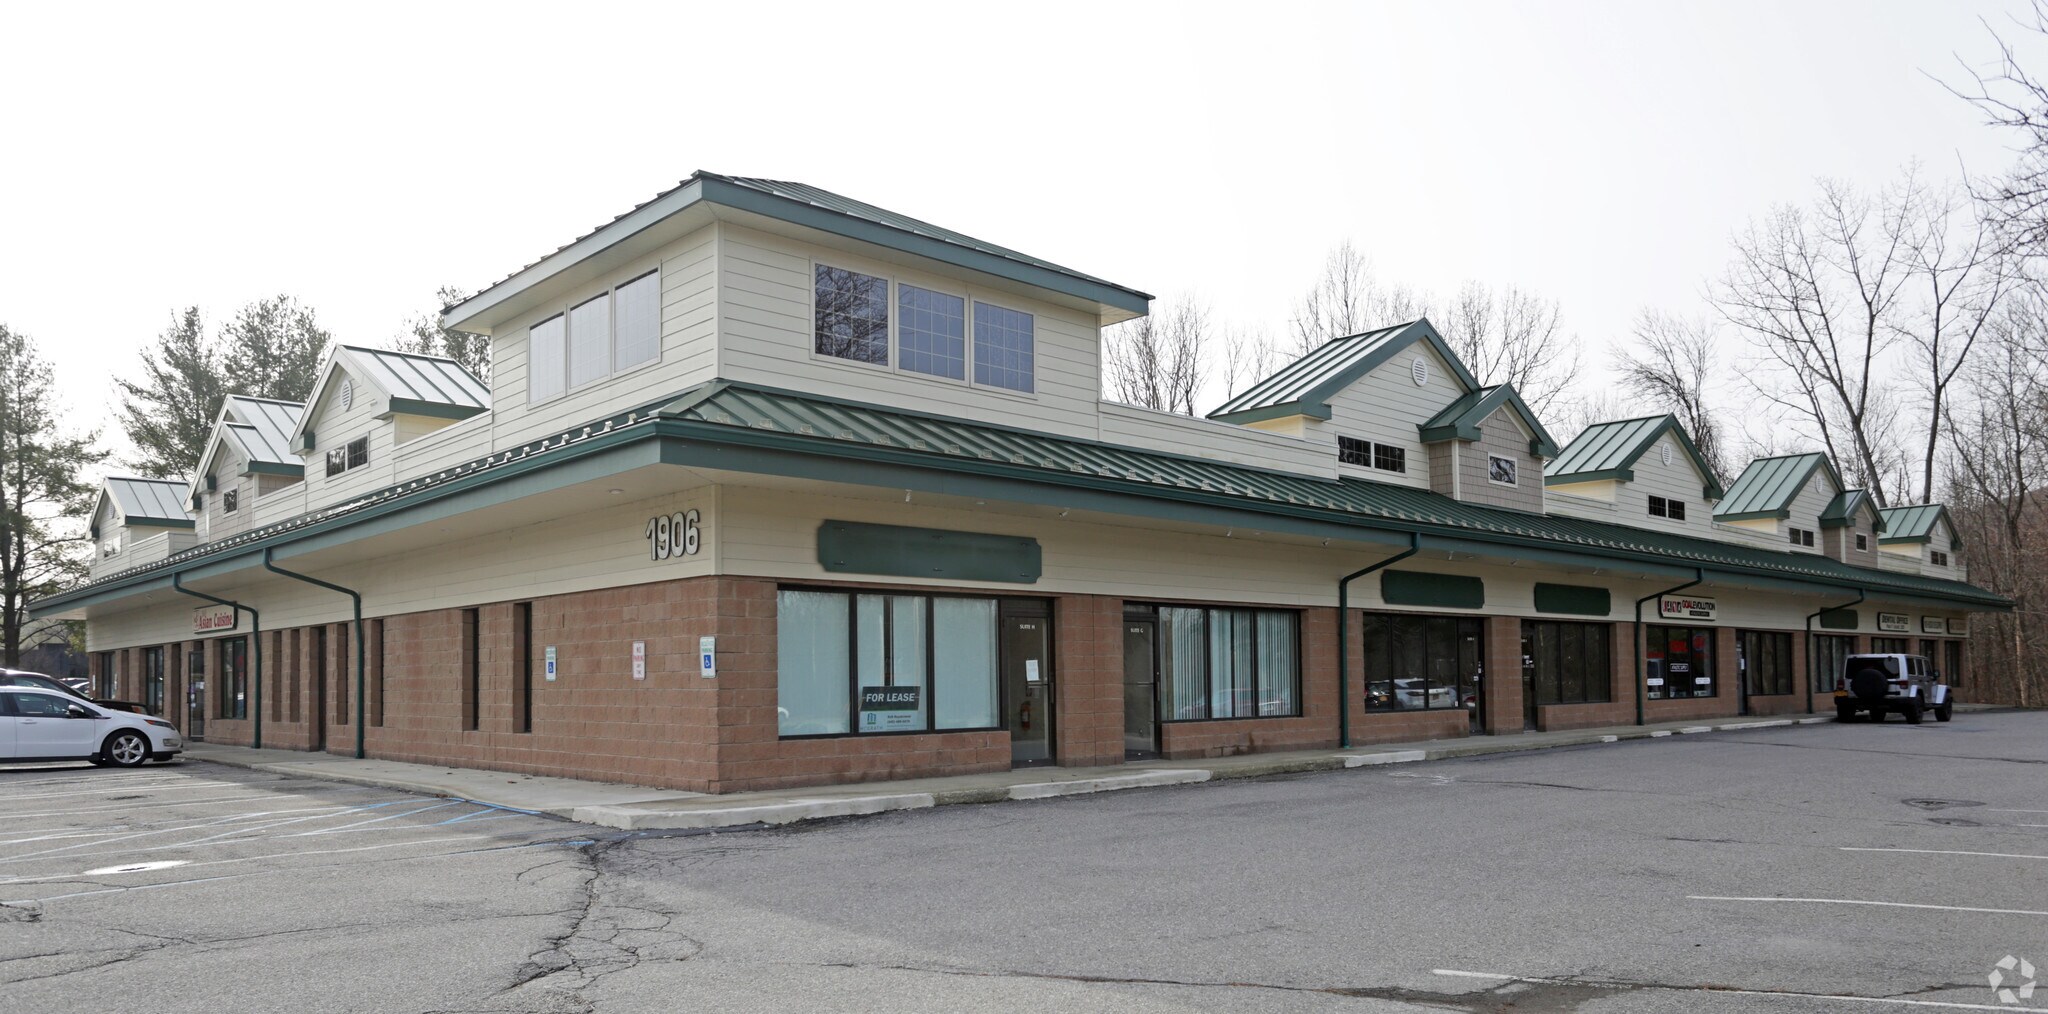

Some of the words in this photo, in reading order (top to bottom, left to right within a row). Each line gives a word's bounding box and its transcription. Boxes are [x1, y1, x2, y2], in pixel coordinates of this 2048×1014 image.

[645, 508, 701, 561] 1906
[199, 615, 212, 629] Asian
[213, 612, 233, 628] Cuisine
[866, 693, 885, 702] FOR
[886, 692, 916, 702] LEASE
